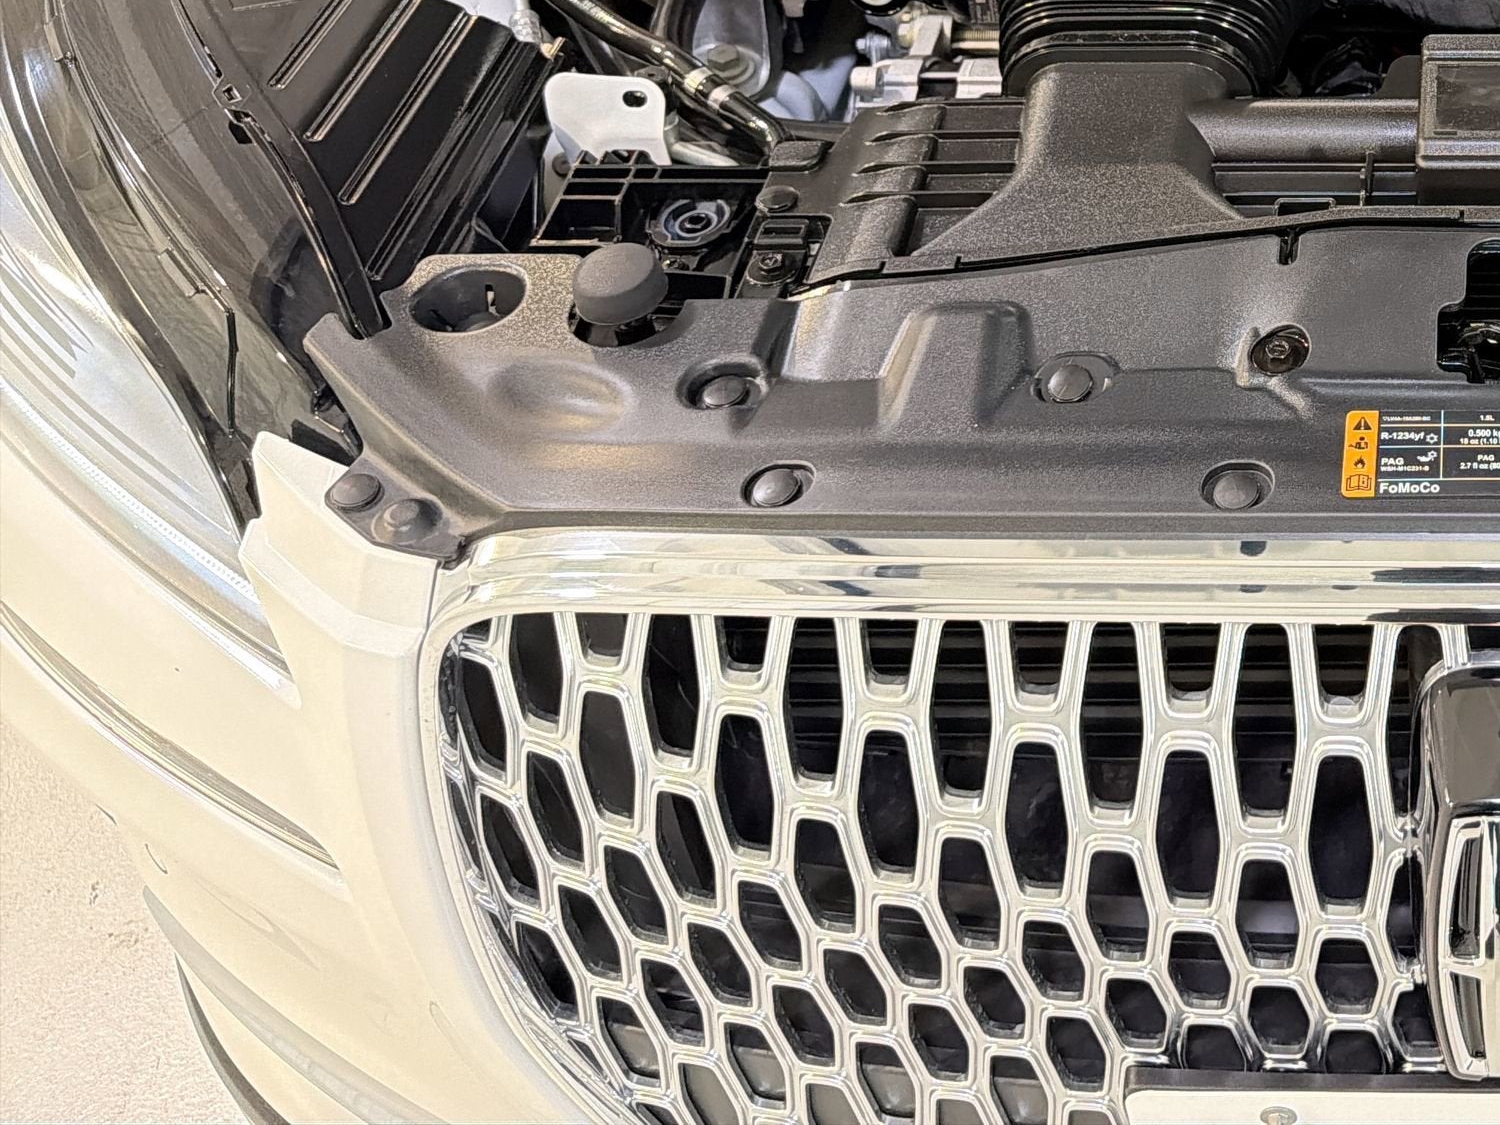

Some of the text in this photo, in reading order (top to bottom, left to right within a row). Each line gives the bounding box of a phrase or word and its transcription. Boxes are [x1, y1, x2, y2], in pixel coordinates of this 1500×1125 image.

[1380, 432, 1425, 441] R-1234yf
[1468, 429, 1491, 437] 0.500
[1379, 482, 1440, 494] FoMoCo
